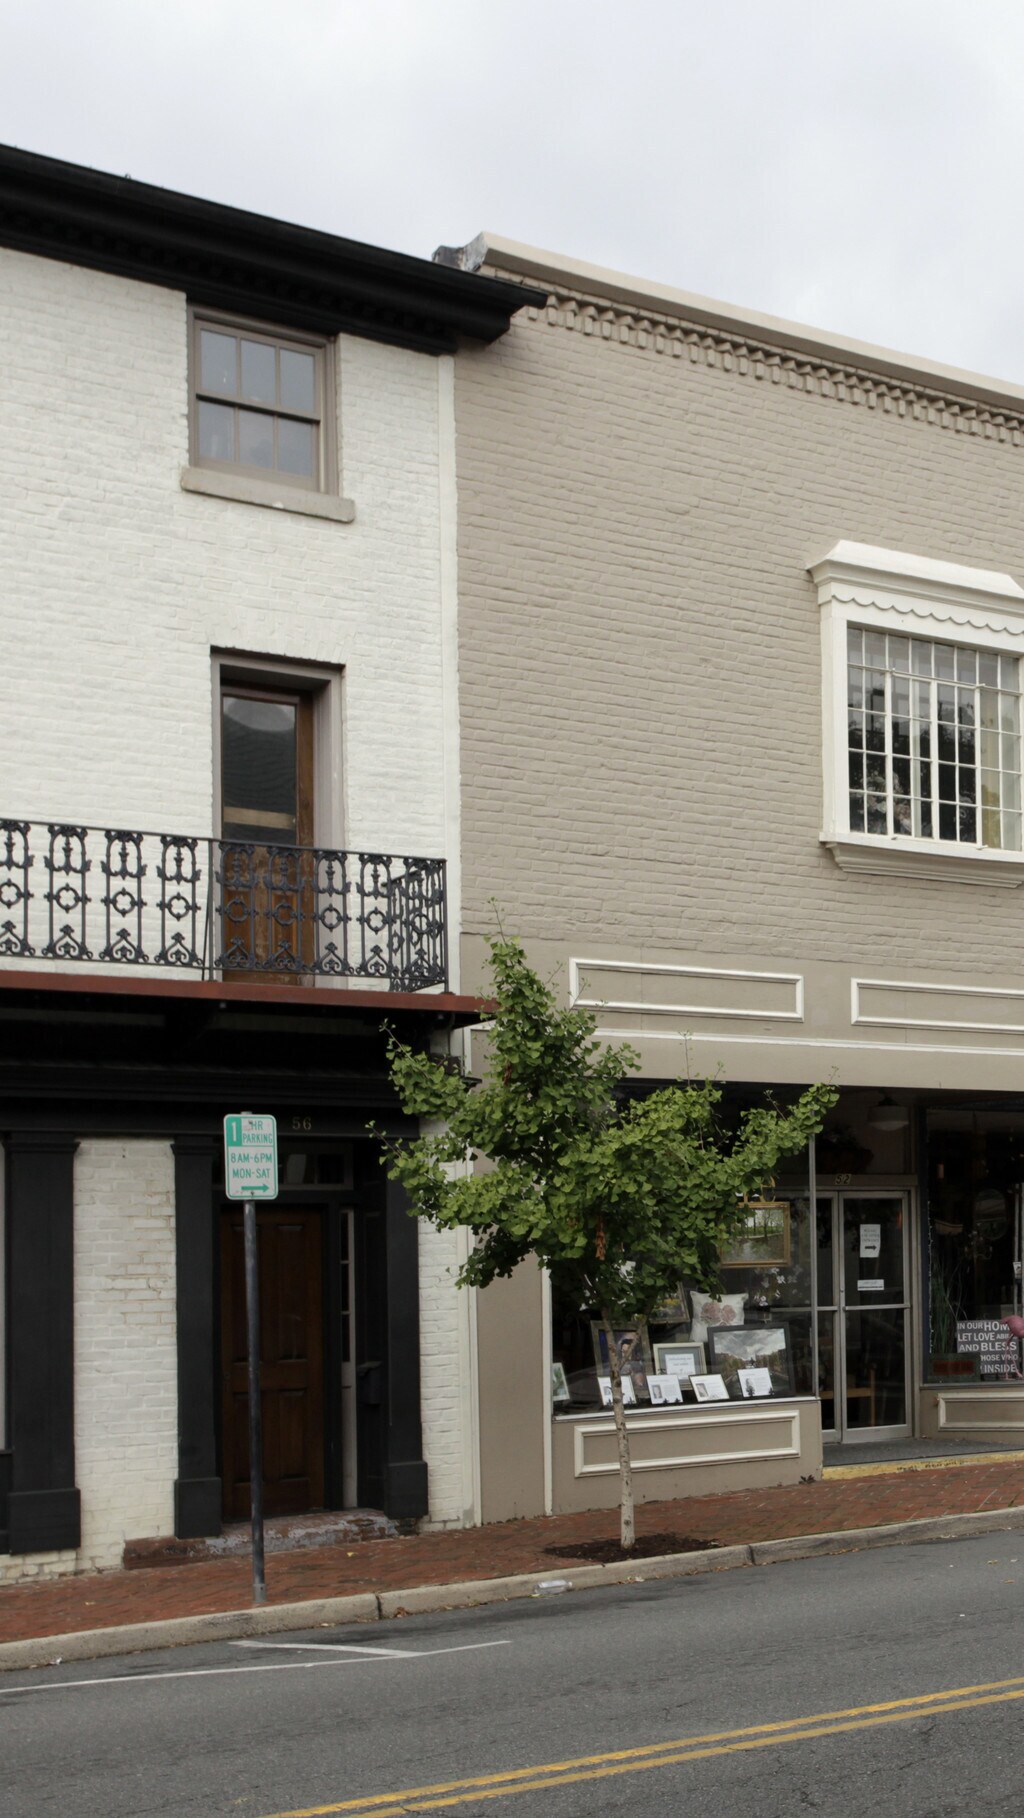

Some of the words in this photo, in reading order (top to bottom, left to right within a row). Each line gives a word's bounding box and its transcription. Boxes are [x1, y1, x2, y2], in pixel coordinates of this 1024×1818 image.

[292, 1117, 312, 1130] 56
[231, 1121, 237, 1142] 1
[251, 1121, 263, 1131] HR
[242, 1133, 273, 1144] PARKING
[232, 1168, 271, 1179] MON-SAT
[836, 1174, 850, 1184] 52
[957, 1322, 966, 1330] IN
[984, 1321, 1010, 1331] HOM
[957, 1332, 972, 1342] LET
[973, 1332, 995, 1341] LOVE
[959, 1343, 979, 1352] AND
[980, 1341, 1017, 1351] BLESS
[984, 1364, 1016, 1373] INSIDE
